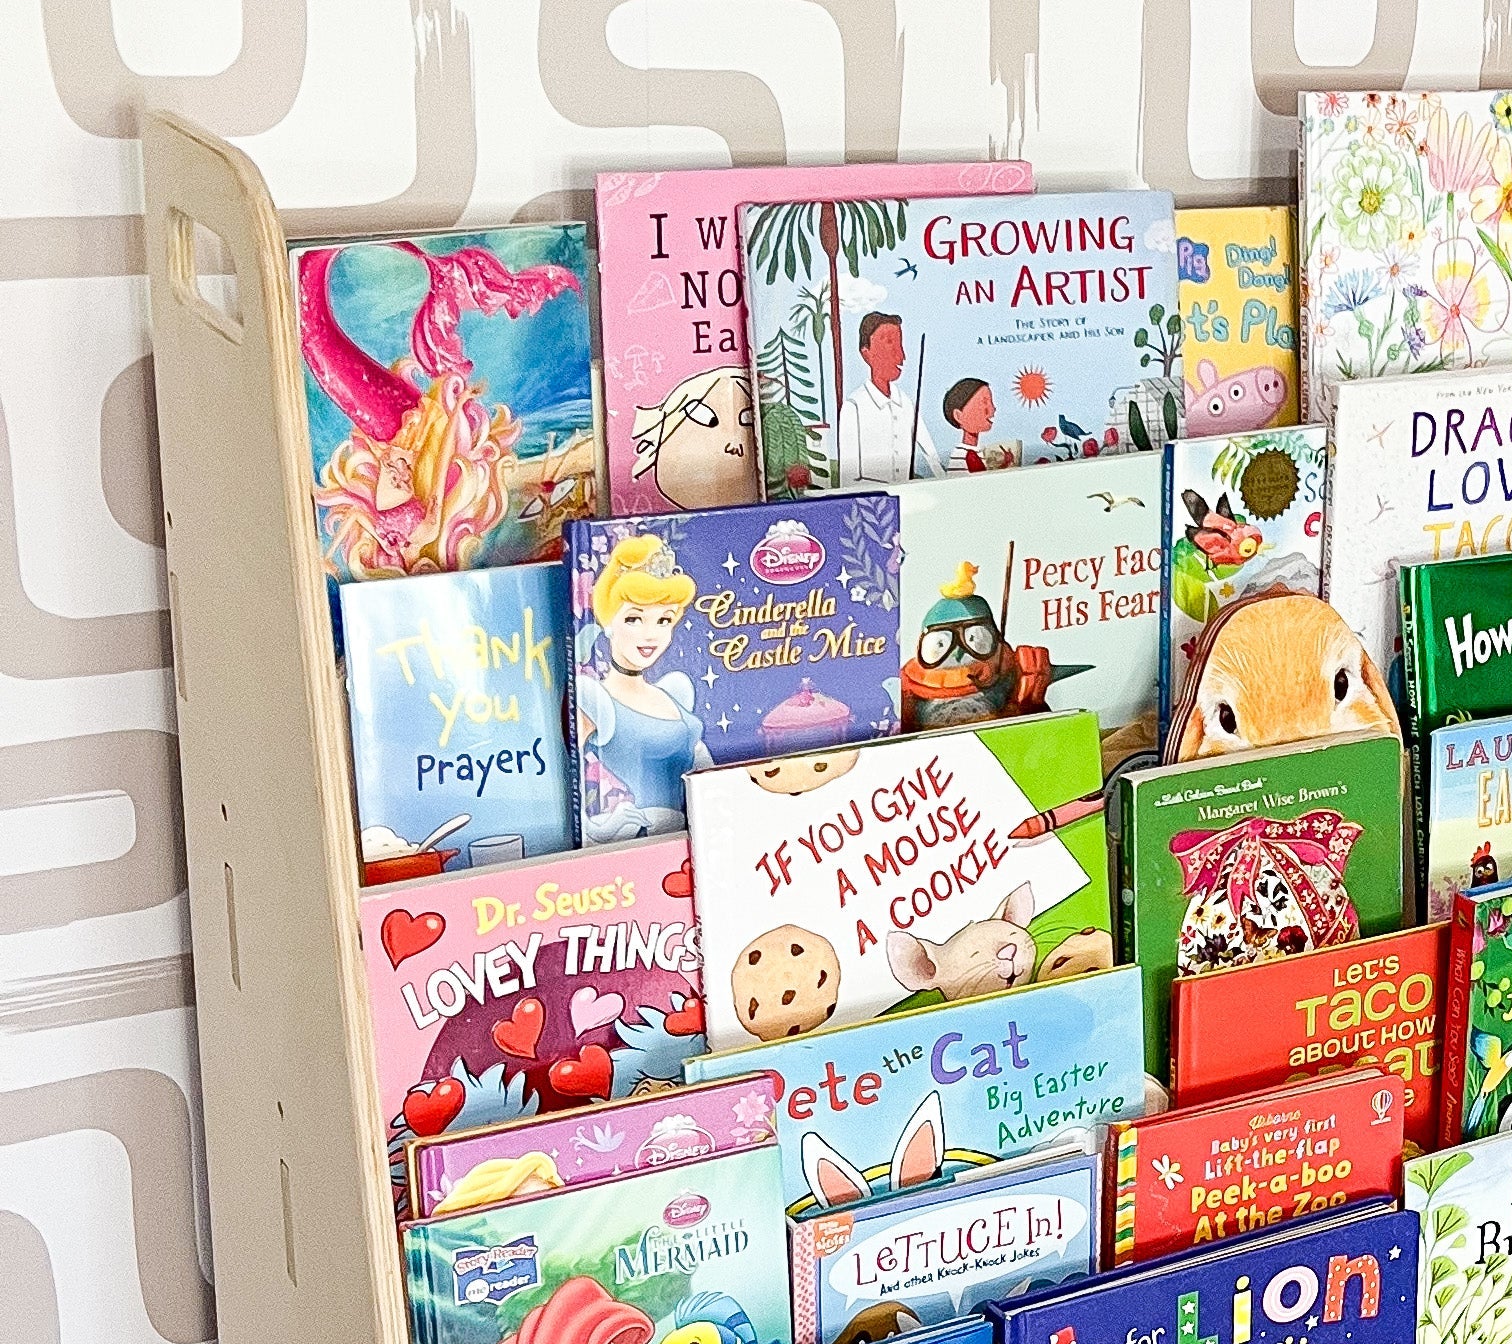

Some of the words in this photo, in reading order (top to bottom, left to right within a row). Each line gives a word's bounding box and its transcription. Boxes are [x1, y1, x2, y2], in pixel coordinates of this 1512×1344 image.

[649, 213, 670, 260] I
[695, 216, 730, 250] W
[924, 216, 1134, 264] GROWING
[680, 269, 744, 309] NO
[955, 280, 995, 305] AN
[1010, 265, 1153, 308] ARTIST
[692, 320, 740, 354] Ea
[988, 332, 1055, 345] LANDSCAPER
[1059, 331, 1080, 340] AND
[1015, 319, 1035, 329] THE
[1040, 317, 1069, 329] STORY
[1183, 299, 1230, 343] t's
[1240, 298, 1297, 351] Pla
[756, 546, 820, 570] Disney
[1022, 550, 1106, 591] Percy
[1114, 543, 1162, 578] Fac
[694, 588, 837, 629] Cinderella
[760, 624, 786, 640] and
[789, 619, 811, 637] the
[1041, 596, 1089, 632] His
[1099, 588, 1162, 623] Fear
[709, 633, 802, 673] Castle
[808, 617, 887, 663] Mice
[416, 736, 546, 798] Prayers
[754, 838, 794, 897] IF
[796, 798, 864, 866] YOU
[870, 754, 955, 825] GIVE
[1197, 799, 1259, 822] Margaret
[1261, 792, 1296, 809] Wise
[1298, 781, 1348, 803] Brown's
[834, 866, 858, 908] A
[863, 796, 982, 887] MOUSE
[471, 894, 527, 937] Dr.
[531, 875, 637, 922] Seuss's
[854, 918, 879, 956] A
[888, 827, 1010, 930] COOKIE
[399, 931, 544, 1031] LOVEY
[558, 918, 704, 976] THINGS
[882, 1040, 924, 1074] the
[930, 1021, 1031, 1086] Cat
[1380, 1014, 1437, 1046] HOW
[986, 1082, 1024, 1115] Big
[1033, 1059, 1109, 1099] Easter
[997, 1092, 1126, 1150] Adventure
[1211, 1131, 1259, 1156] Baby's
[1263, 1126, 1299, 1143] very
[1303, 1113, 1337, 1135] first
[1204, 1137, 1341, 1181] Lift-the-flap
[1190, 1159, 1353, 1214] Peek-a-boo
[696, 1218, 745, 1239] LITTLE
[1025, 1198, 1064, 1246] In!
[1193, 1211, 1228, 1244] At
[1235, 1203, 1284, 1233] the
[1292, 1190, 1347, 1217] Zoo
[614, 1225, 750, 1284] MERMAID
[879, 1283, 900, 1297] And
[936, 1253, 1008, 1282] Knock-Knock
[1010, 1247, 1041, 1263] Jokes
[489, 1273, 531, 1293] reader
